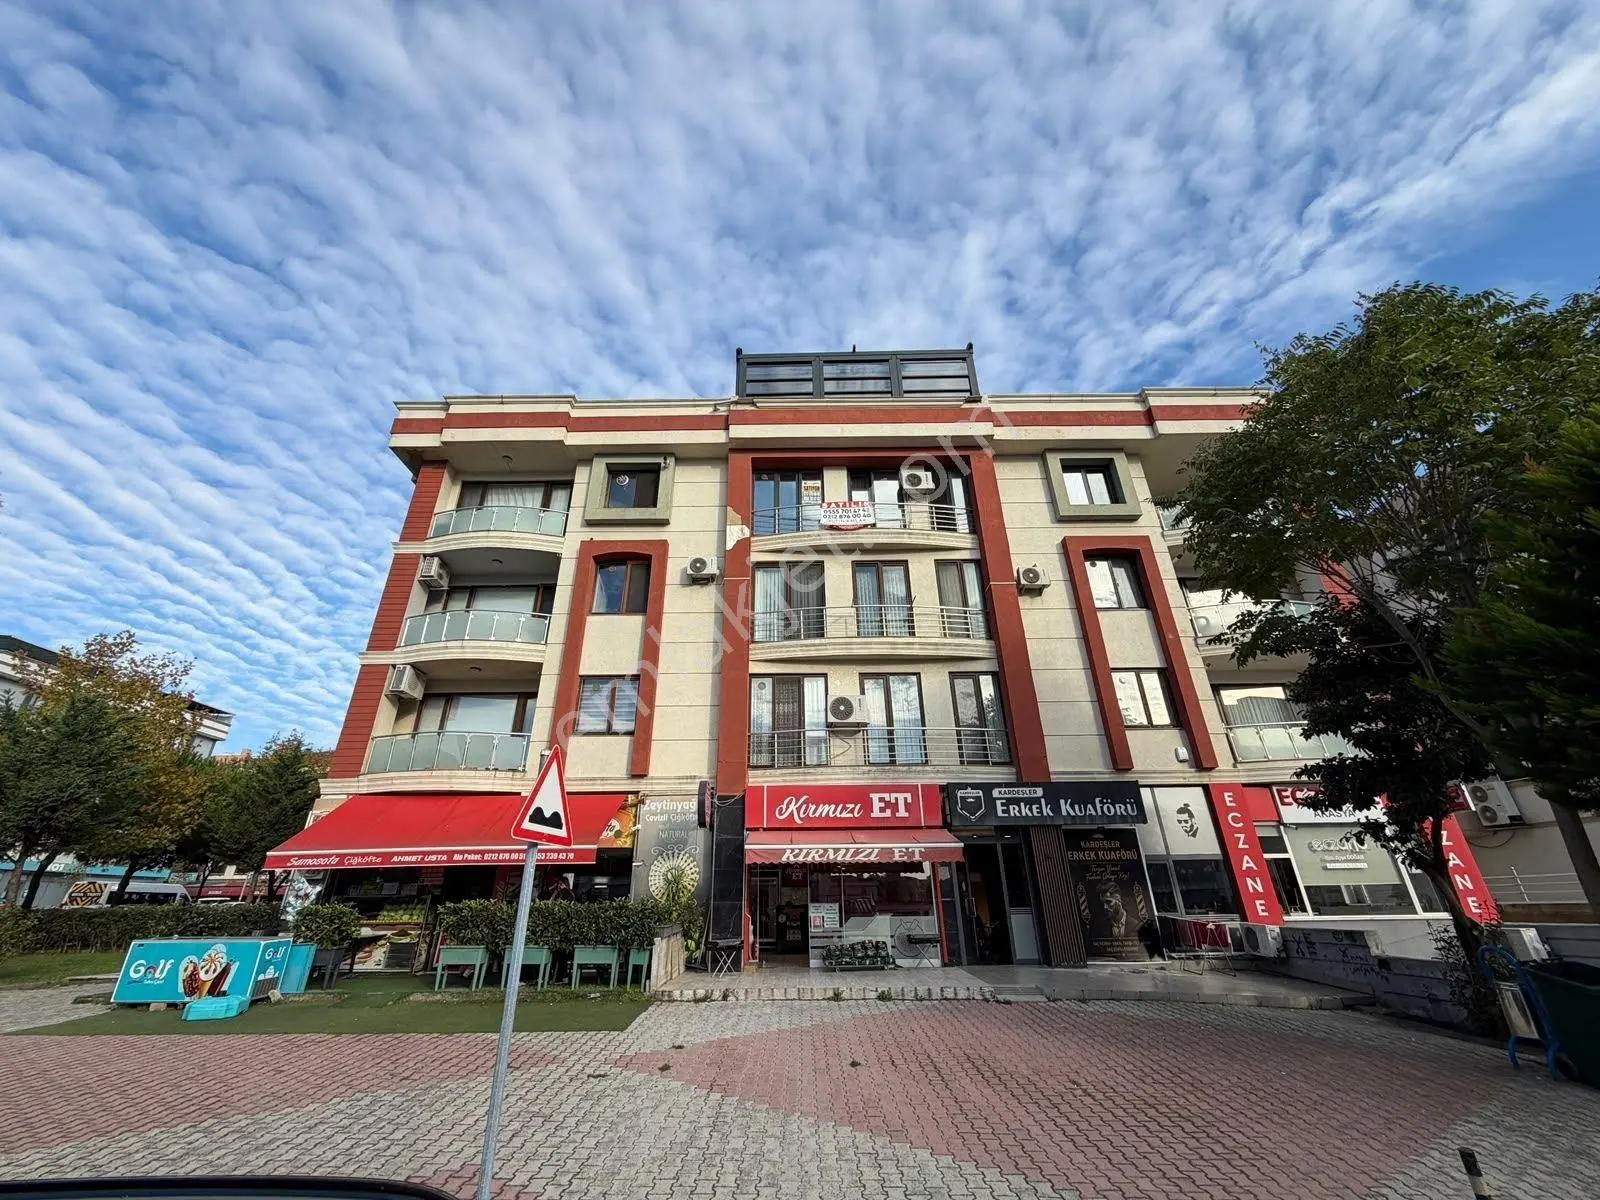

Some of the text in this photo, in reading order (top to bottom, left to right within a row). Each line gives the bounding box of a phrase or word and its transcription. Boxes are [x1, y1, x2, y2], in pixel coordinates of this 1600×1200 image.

[998, 789, 1038, 797] KARDEŞLER
[643, 799, 697, 812] Zeytinyağ
[775, 792, 912, 824] Kırmızı ET
[645, 813, 668, 822] Cevizli
[1313, 808, 1356, 818] AKASYA
[659, 831, 688, 839] NATURAL
[1080, 840, 1121, 849] KARDEŞLER
[286, 854, 339, 867] Samosata
[391, 855, 422, 863] AHMET
[424, 854, 448, 862] USTA
[483, 852, 499, 860] 0212
[546, 852, 558, 860] 239
[559, 852, 567, 860] 43
[567, 852, 575, 860] 70
[892, 848, 926, 861] ET
[1067, 848, 1138, 860] ERKEK KUAFÖRÜ
[1223, 791, 1269, 917] ECZANE
[1440, 830, 1483, 914] ZANE
[265, 945, 287, 960] Golf
[129, 959, 175, 980] Golf
